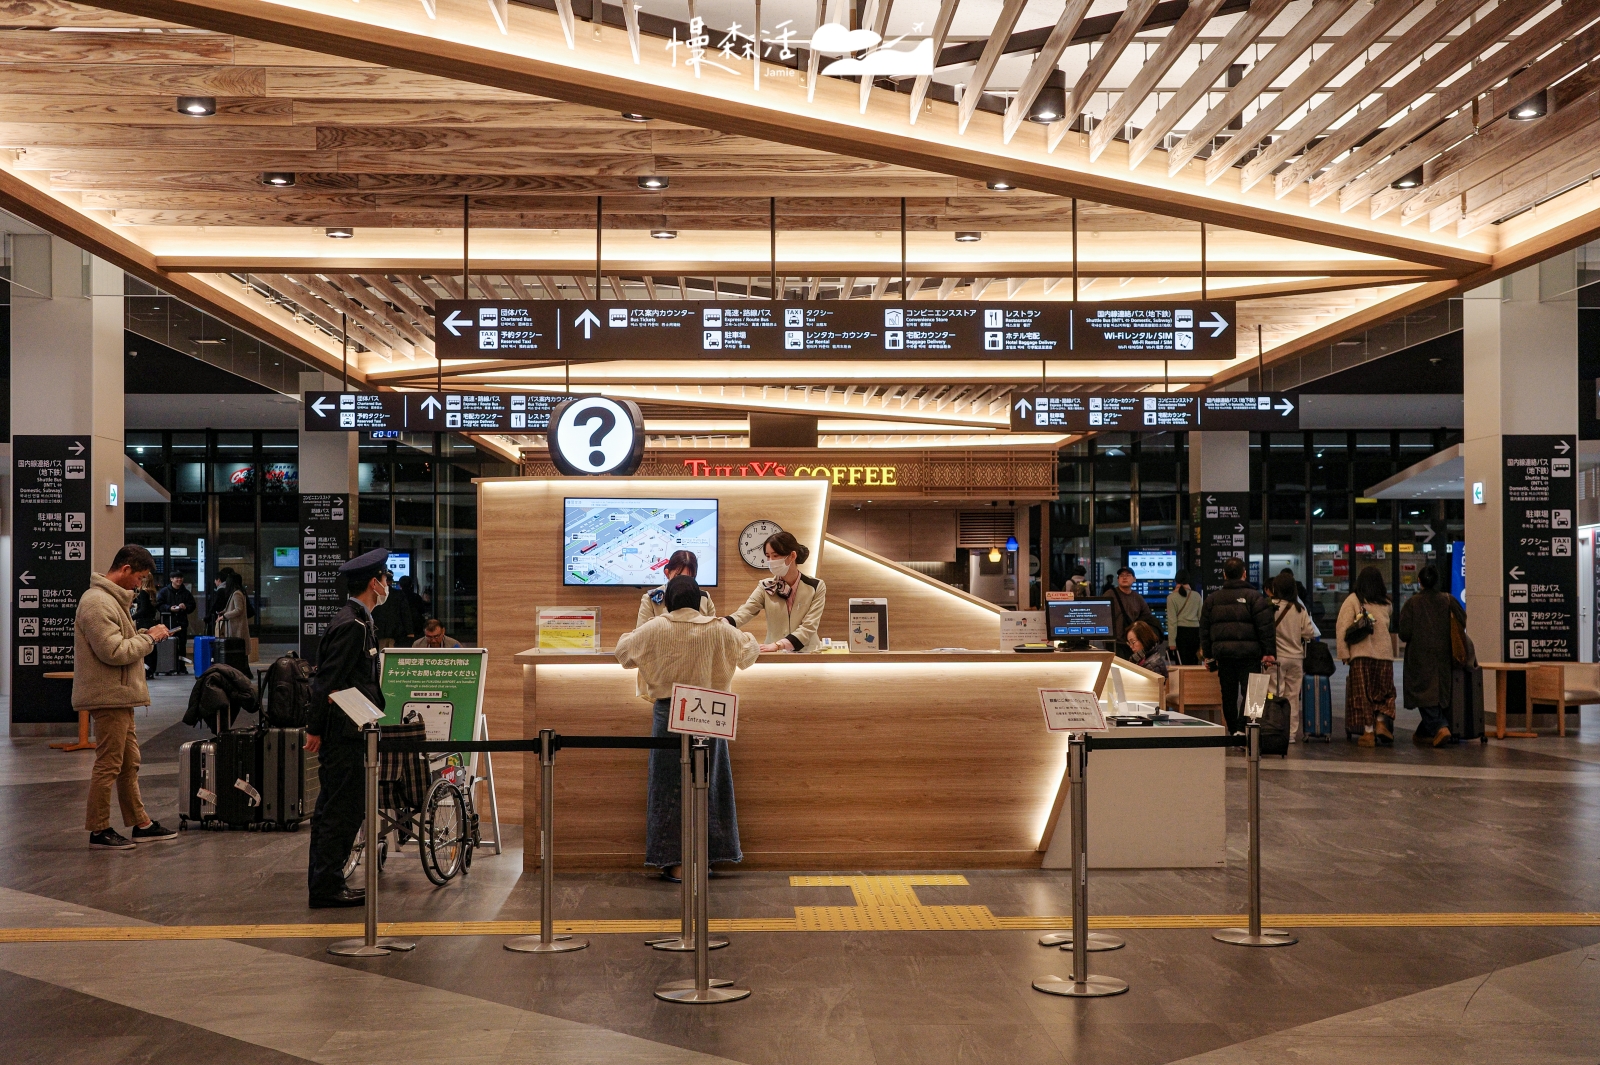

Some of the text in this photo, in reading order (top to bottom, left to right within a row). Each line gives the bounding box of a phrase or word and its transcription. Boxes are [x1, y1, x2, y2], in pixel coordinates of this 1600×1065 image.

[500, 308, 529, 317] 団体バス
[630, 309, 695, 317] バス案内カウンター
[806, 309, 834, 317] タクシー
[906, 309, 976, 317] コンビニエンスストア
[1006, 310, 1041, 318] レストラン
[500, 331, 543, 339] 予約タクシー
[705, 332, 712, 340] P
[725, 331, 746, 339] 駐車場
[806, 331, 877, 339] レンタカーカウンター
[906, 331, 955, 339] 宅配カウンター
[1006, 332, 1040, 340] ホテル宅配
[18, 460, 62, 468] 国内線連絡バス
[1507, 459, 1549, 467] 国内線連絡バス
[794, 466, 897, 486] COFFEE
[38, 513, 62, 521] 駐車場
[68, 514, 74, 522] P
[1526, 510, 1549, 518] 駐車場
[1554, 511, 1560, 519] P
[31, 541, 62, 549] タクシー
[1520, 538, 1549, 546] タクシー
[1531, 584, 1560, 592] 団体バス
[42, 589, 73, 597] 団体バス
[1531, 612, 1570, 620] 予約タクシー
[398, 658, 469, 666] 福岡空港でのお忘れ物は
[691, 697, 726, 717] 入口
[687, 716, 710, 725] Entrance
